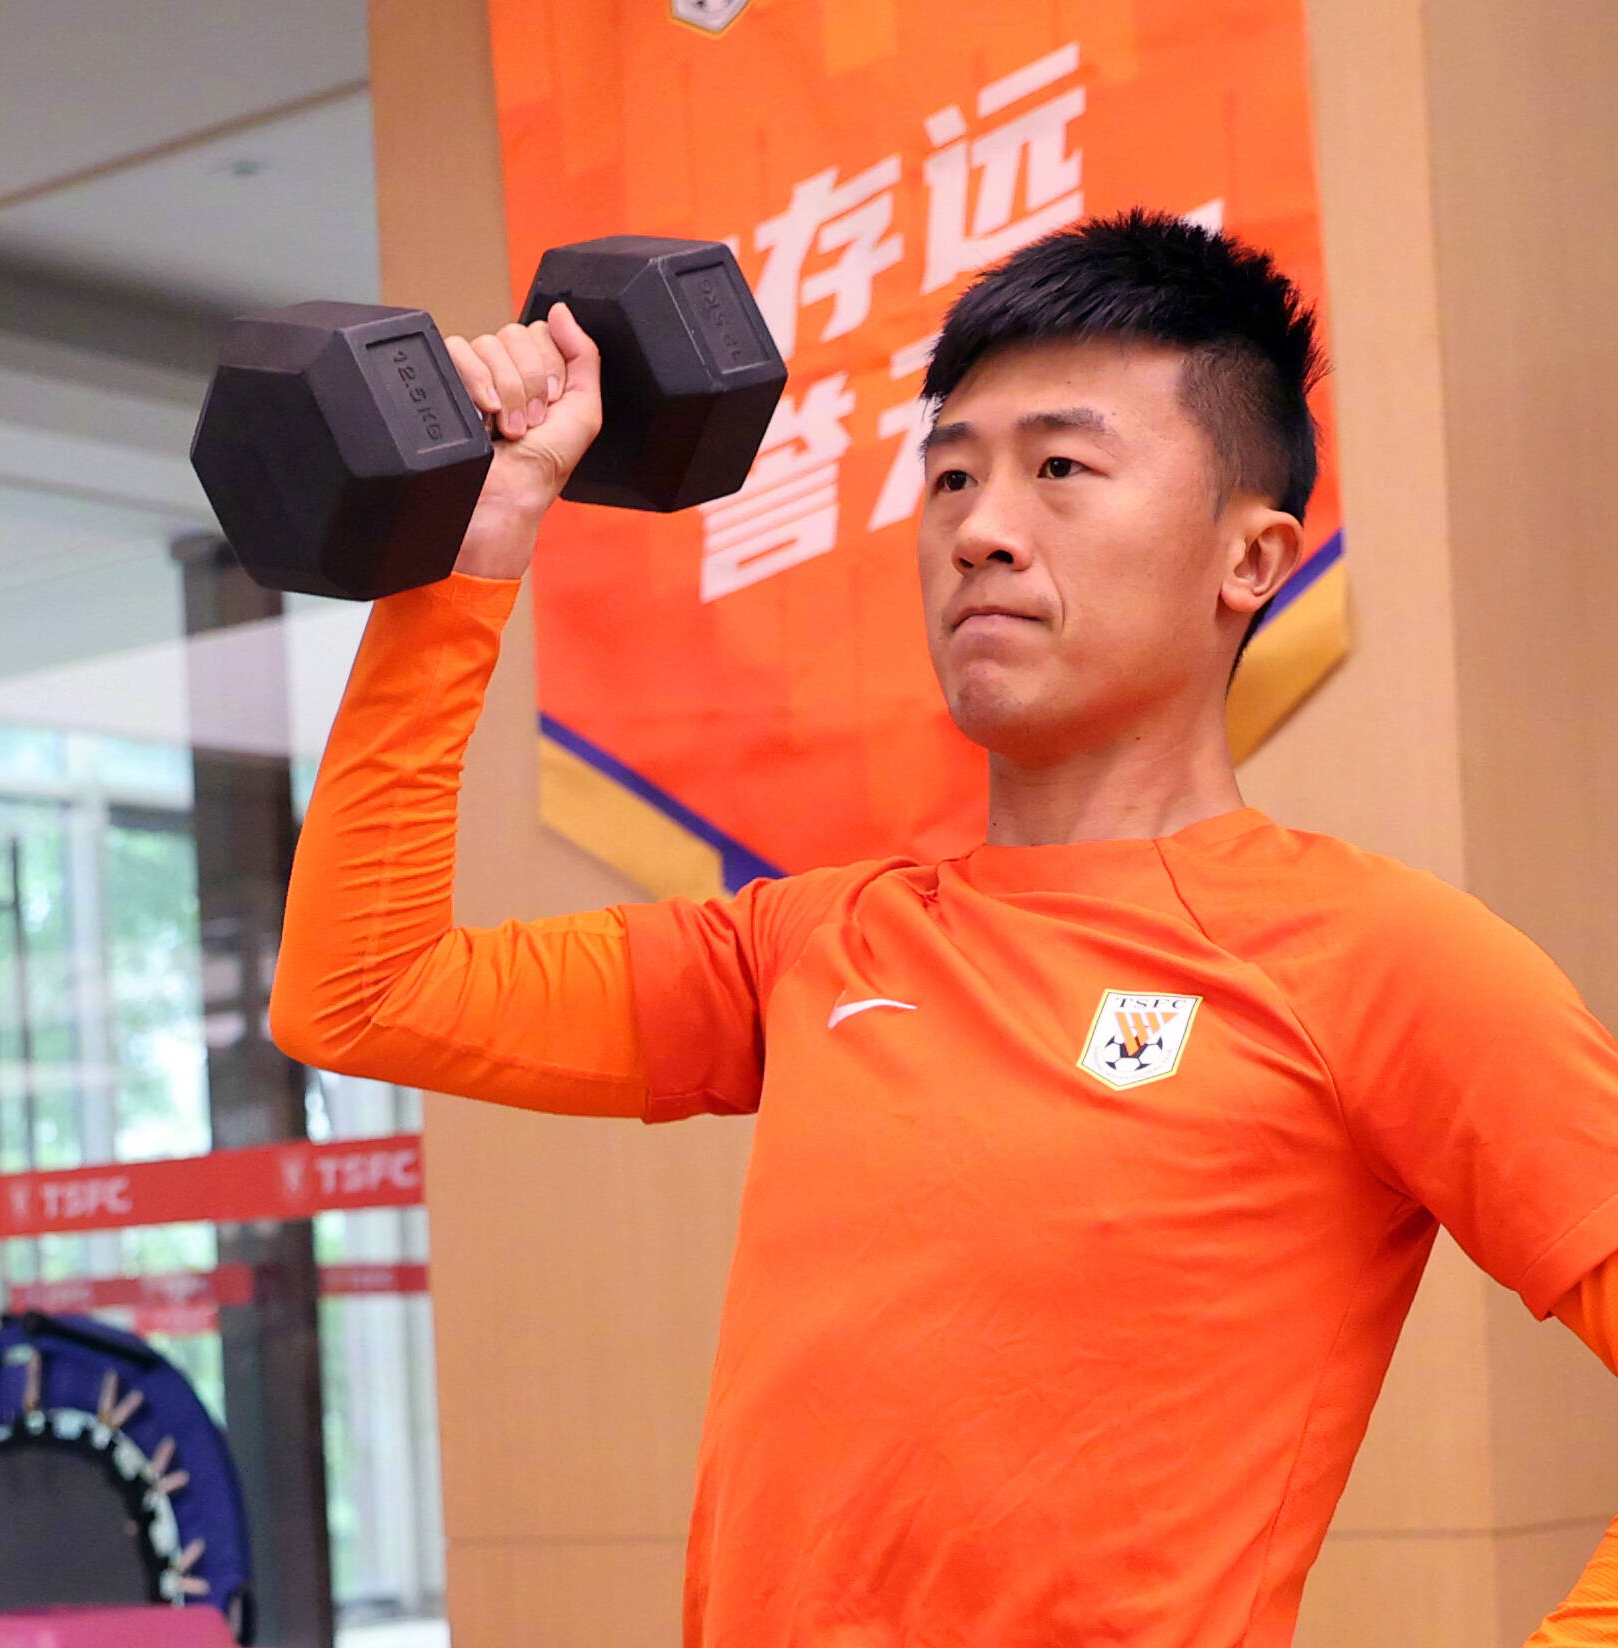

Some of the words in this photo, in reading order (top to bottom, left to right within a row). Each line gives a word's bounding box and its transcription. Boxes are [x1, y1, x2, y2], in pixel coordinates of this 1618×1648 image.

[725, 41, 1087, 363] 存远
[392, 350, 444, 441] 12.5KG
[1116, 997, 1187, 1009] TSFC
[315, 1150, 421, 1196] TSFC
[42, 1175, 133, 1221] TSFC
